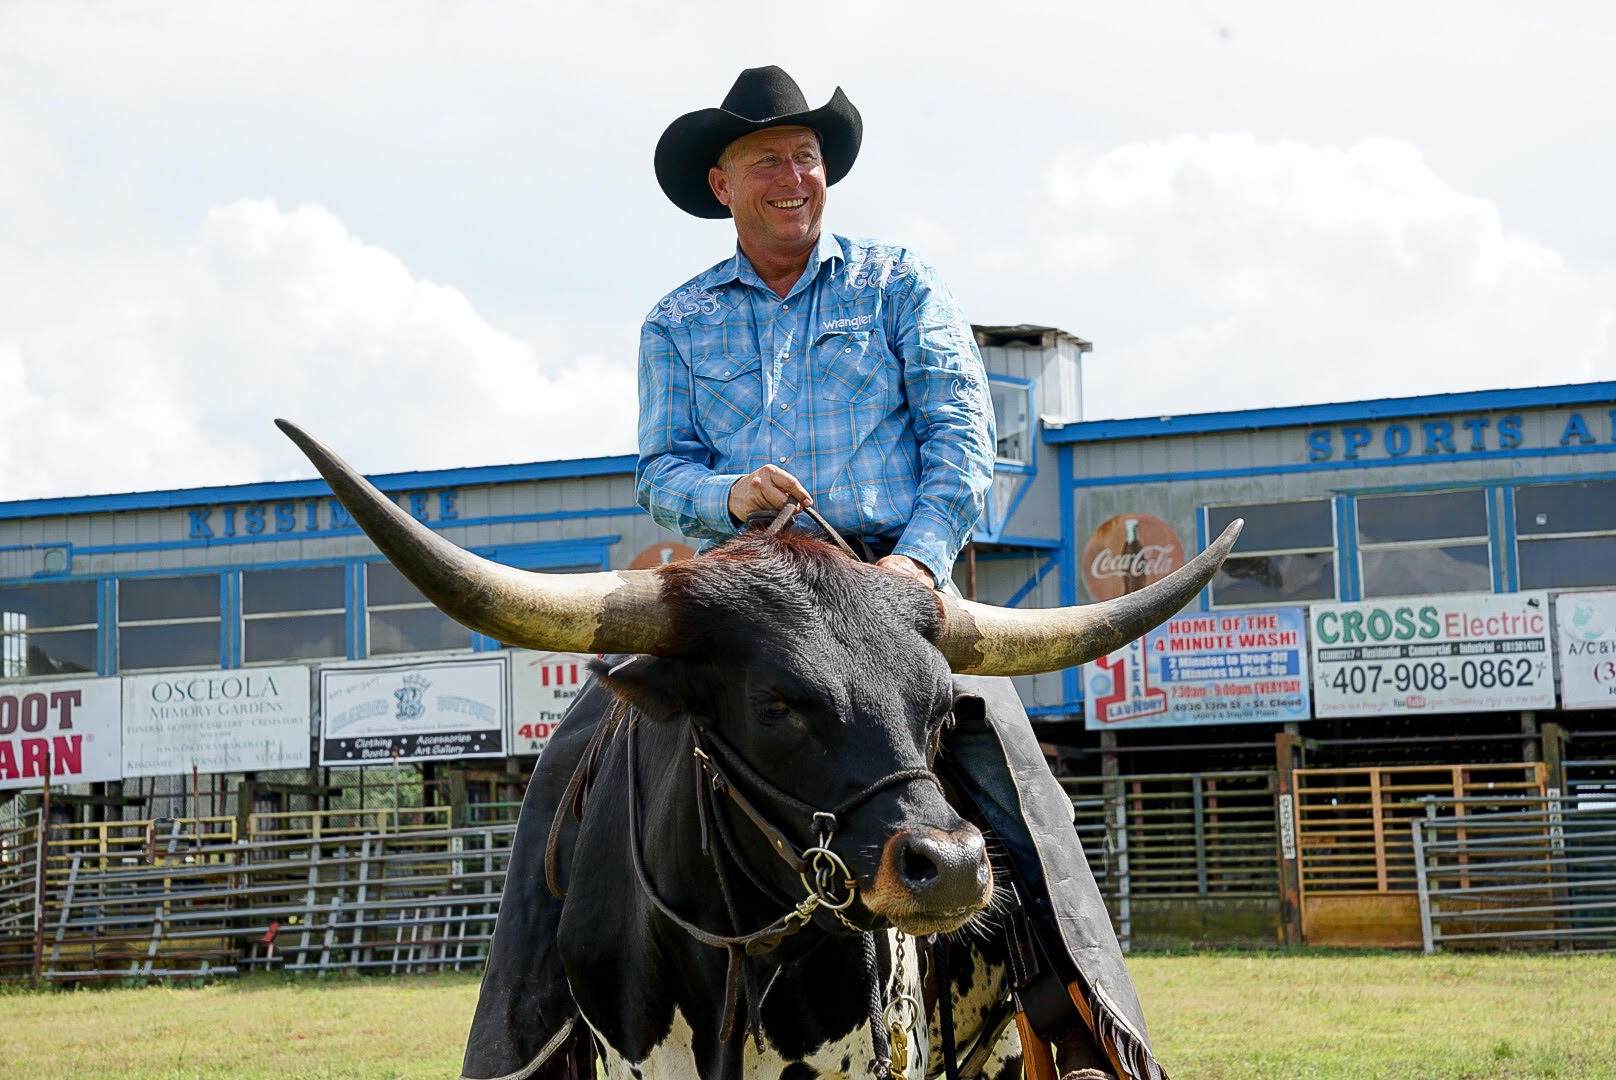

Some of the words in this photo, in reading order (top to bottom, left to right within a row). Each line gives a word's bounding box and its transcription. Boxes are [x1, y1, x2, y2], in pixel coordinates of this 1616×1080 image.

[823, 314, 872, 330] Wrangler
[1307, 415, 1523, 463] SPORTS
[1560, 412, 1616, 446] A
[188, 490, 457, 539] KISSIMEE
[1168, 617, 1217, 634] HOME
[1221, 616, 1240, 631] OF
[1244, 614, 1277, 630] THE
[1316, 606, 1441, 644] CROSS
[1444, 608, 1545, 638] Electric
[1154, 638, 1165, 652] 4
[1169, 635, 1235, 652] MINUTE
[1238, 631, 1297, 648] WASH!
[1168, 657, 1177, 669] 2
[1178, 655, 1225, 668] Minutes
[1226, 654, 1239, 666] to
[1240, 652, 1288, 665] Drop-Off
[1170, 669, 1179, 681] 2
[1180, 668, 1227, 680] Minutes
[1228, 666, 1241, 678] to
[1242, 664, 1287, 677] Pick-Up
[1333, 658, 1534, 694] 407-908-0862
[152, 675, 279, 703] OSCEOLA
[553, 688, 580, 699] Ban
[1254, 680, 1300, 693] EVERYDAY
[150, 704, 212, 720] MEMORY
[218, 702, 283, 717] GARDENS
[540, 711, 563, 721] Firs
[1108, 699, 1162, 717] LAUNDRY
[355, 737, 392, 749] Clothing
[416, 734, 472, 745] Accessories
[362, 748, 390, 759] Boots
[414, 746, 431, 755] Art
[432, 745, 465, 755] Gallery
